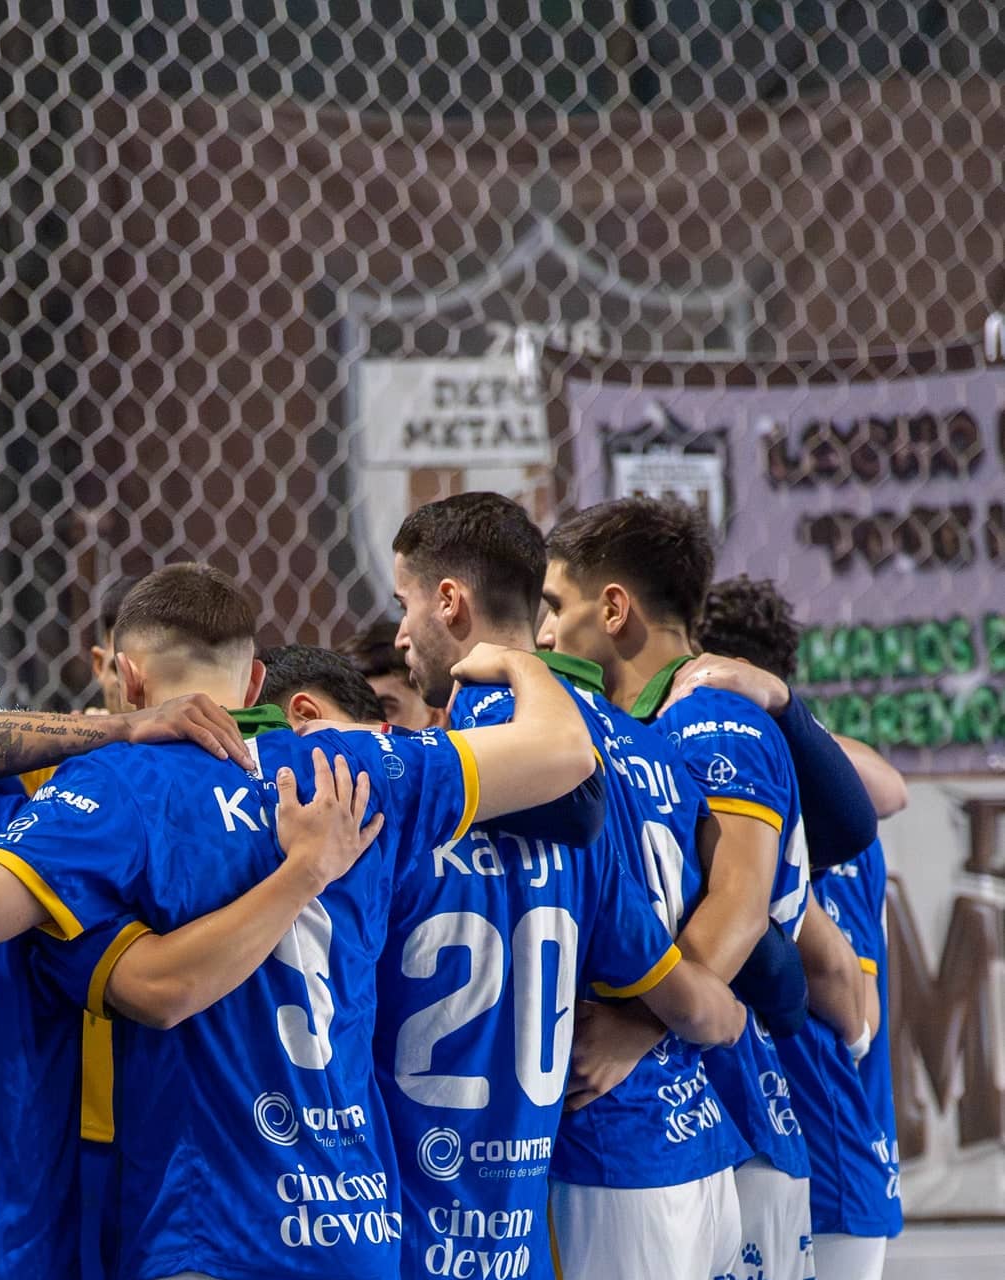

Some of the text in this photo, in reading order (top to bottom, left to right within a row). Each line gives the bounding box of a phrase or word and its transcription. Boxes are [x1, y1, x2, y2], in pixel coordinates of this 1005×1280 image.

[32, 785, 100, 814] MAR-PLAST
[395, 905, 579, 1109] 20
[427, 1199, 534, 1241] cinem
